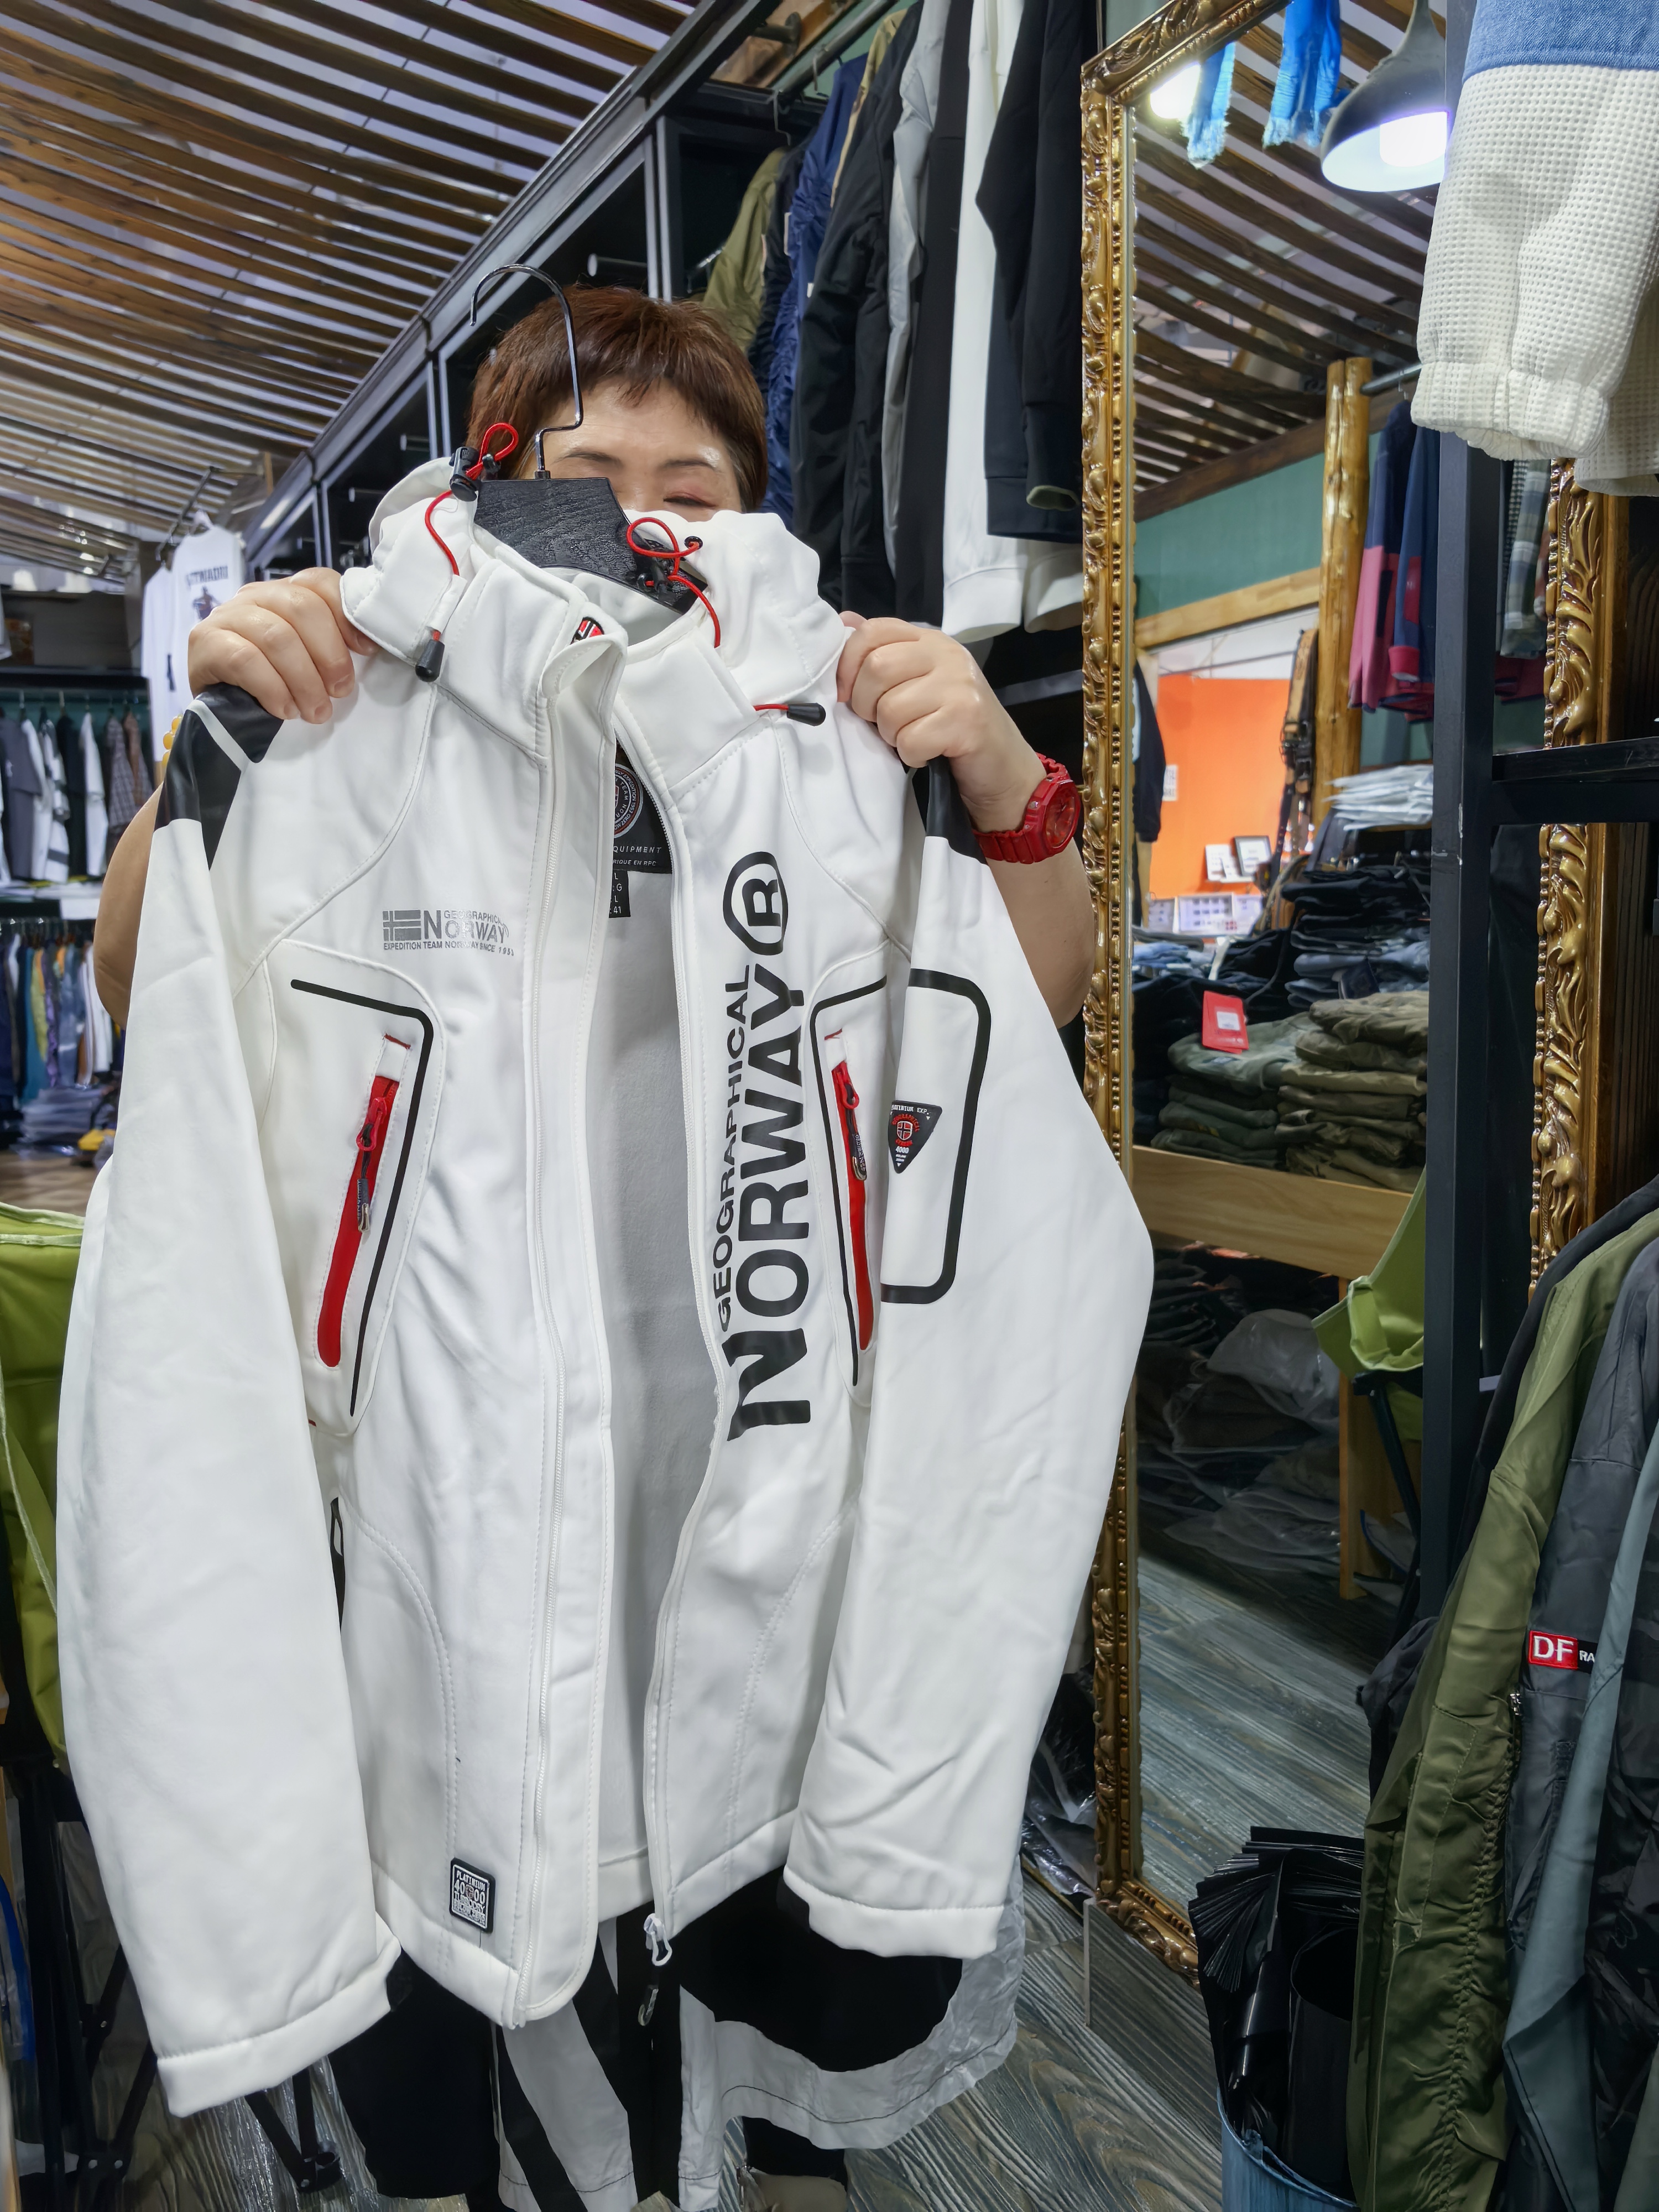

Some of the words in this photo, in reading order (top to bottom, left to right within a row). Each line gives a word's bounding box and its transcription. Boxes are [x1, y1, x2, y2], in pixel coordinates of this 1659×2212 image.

[620, 781, 629, 801] TEAM
[613, 846, 662, 854] QUIPMENT
[424, 910, 505, 944] NORWAY
[383, 942, 421, 951] EXPEDITION
[423, 941, 442, 949] TEAM
[712, 964, 749, 1332] GEOGRAPHICAL
[721, 963, 811, 1442] NORWAY
[1533, 1635, 1574, 1662] DF
[1579, 1650, 1595, 1662] RA
